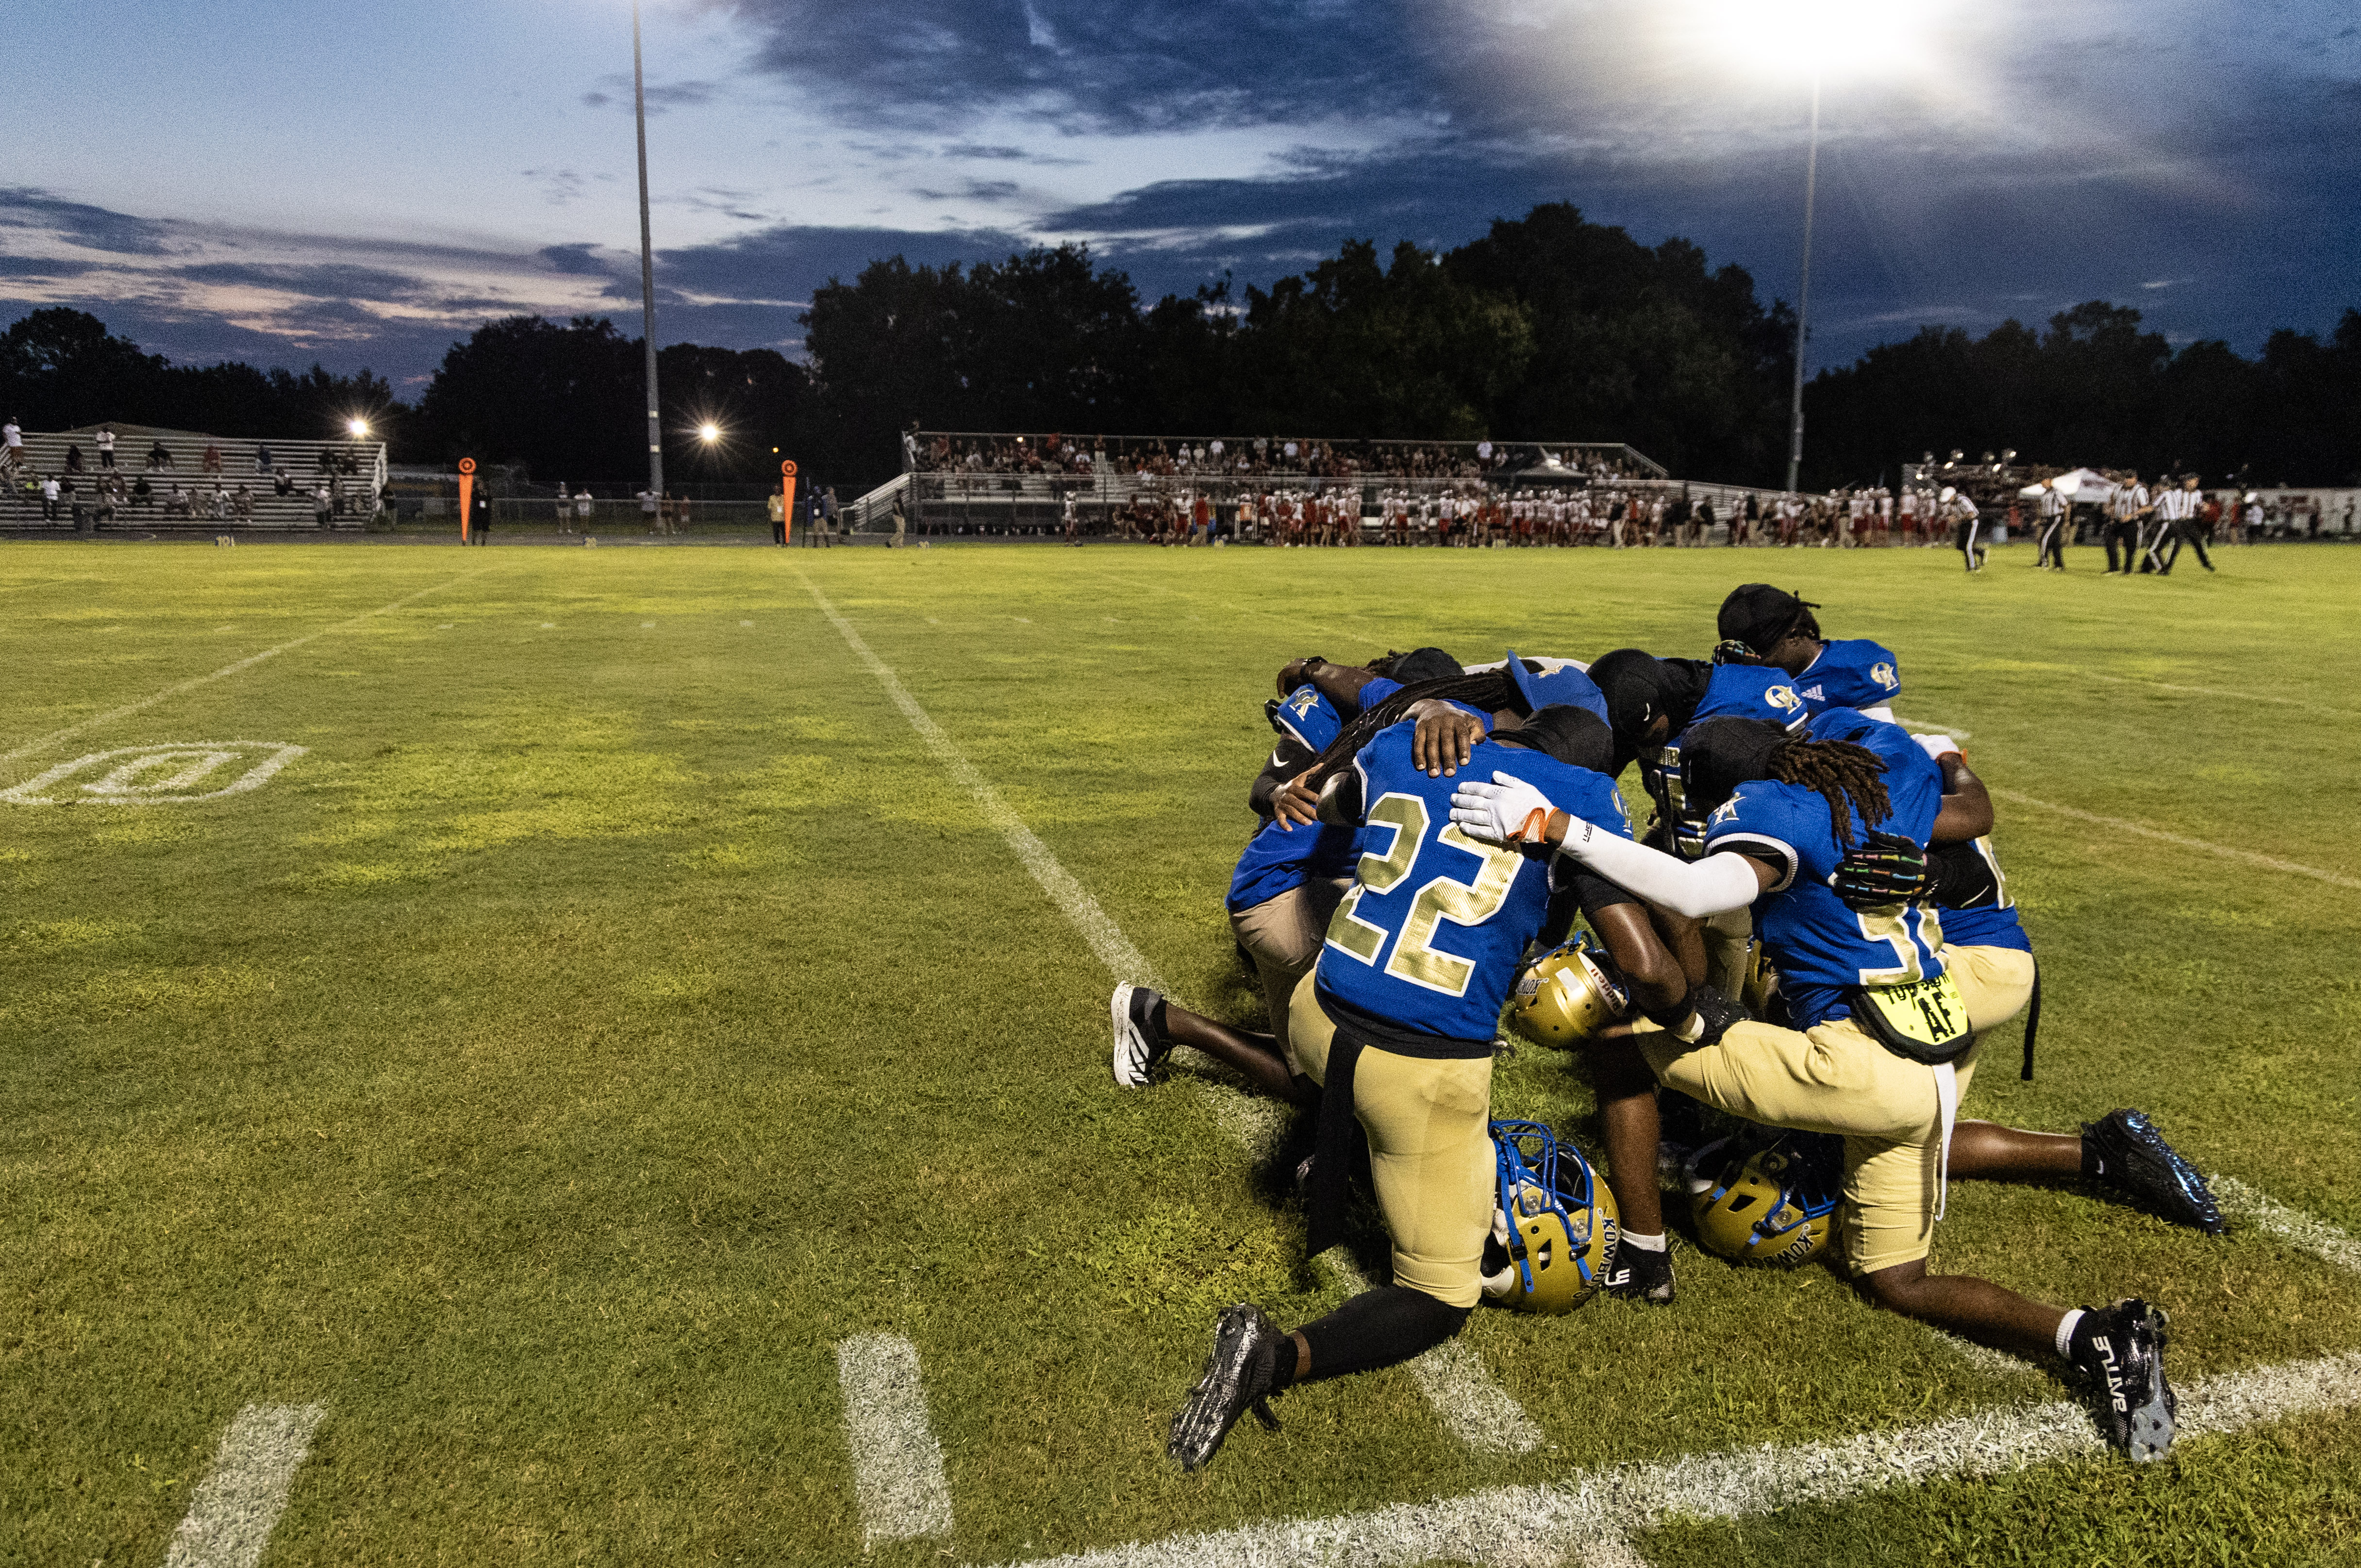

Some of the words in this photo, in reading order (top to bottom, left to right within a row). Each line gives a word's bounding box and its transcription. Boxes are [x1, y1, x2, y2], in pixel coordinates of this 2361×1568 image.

[1325, 792, 1525, 998] 22
[1917, 991, 1957, 1042] AF
[2092, 1336, 2128, 1413] BATTLE
